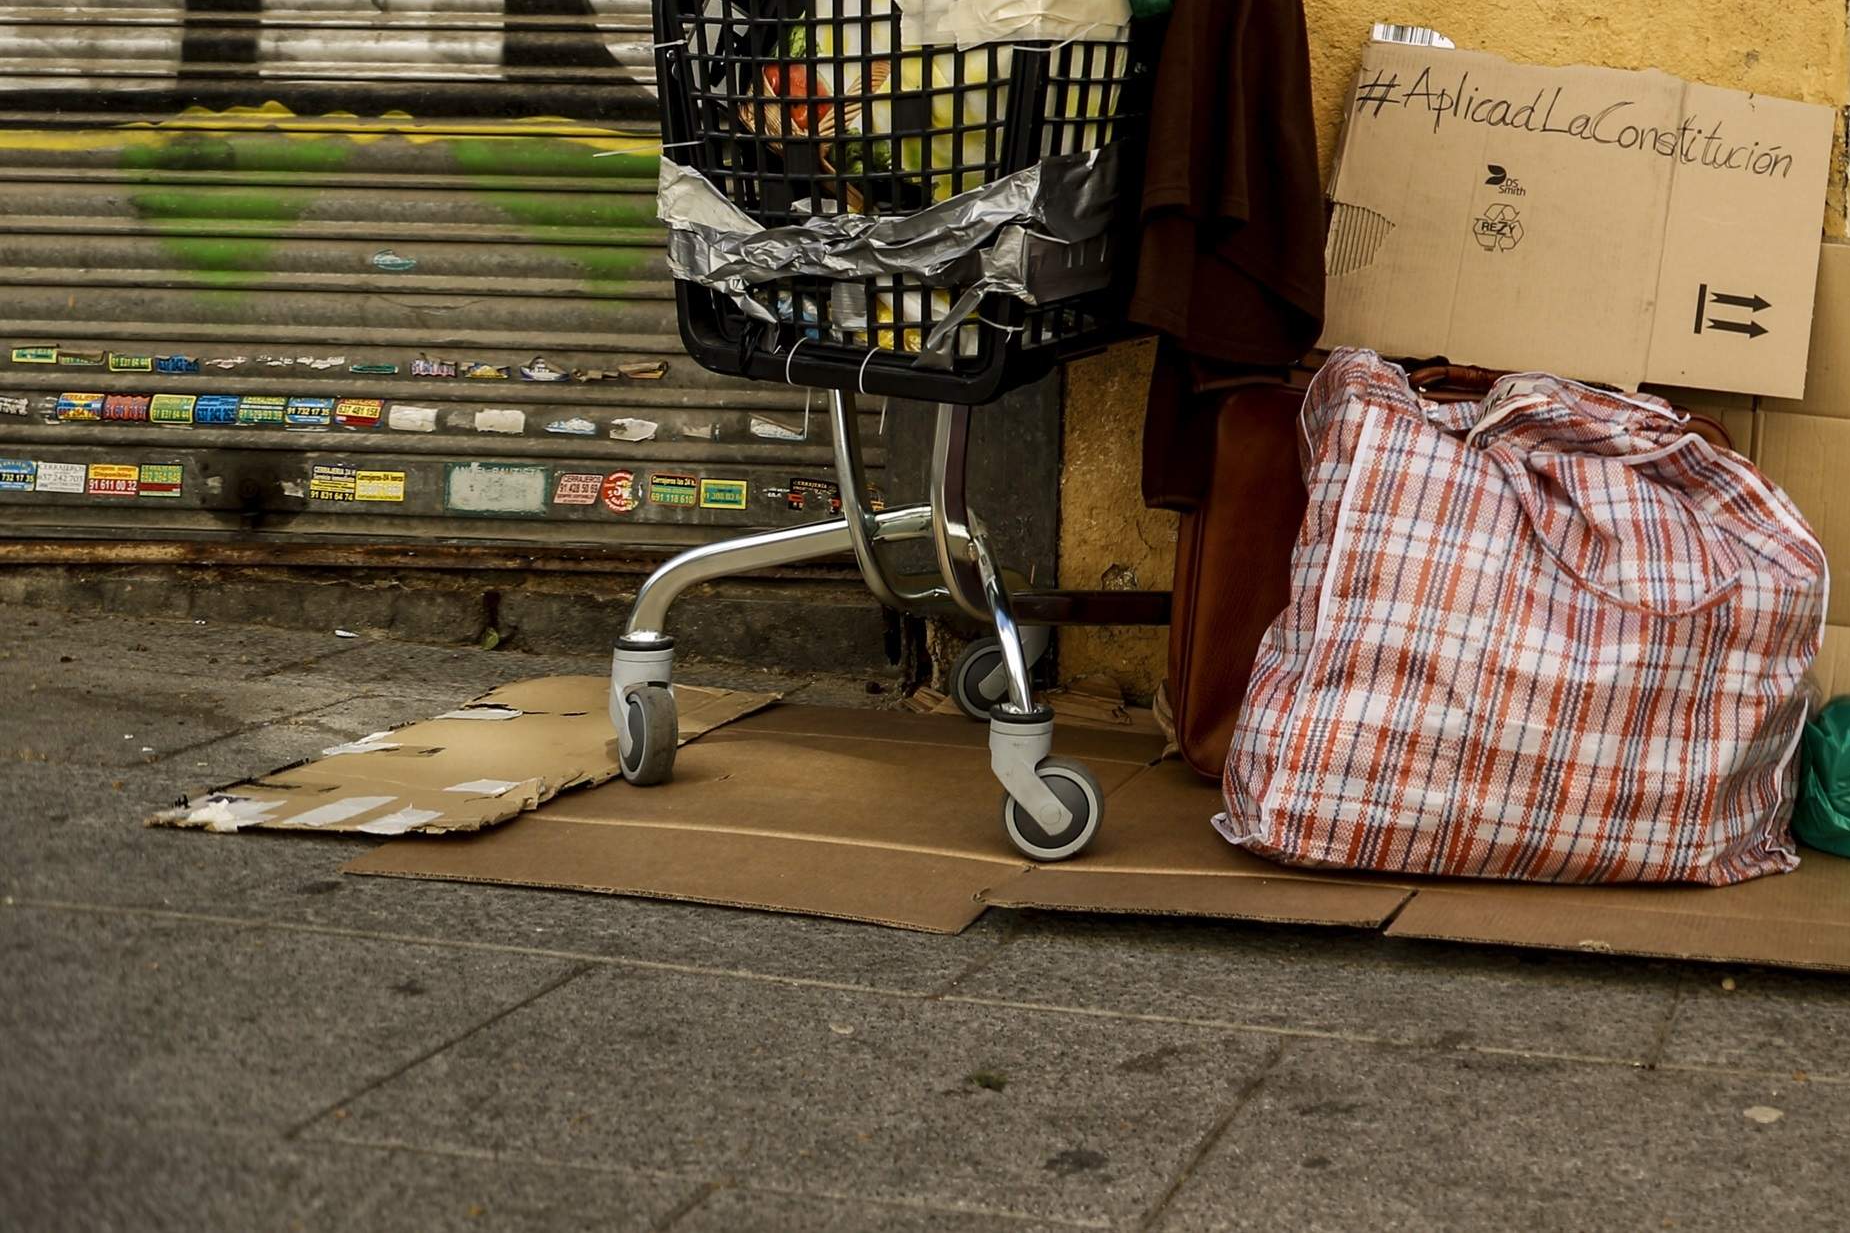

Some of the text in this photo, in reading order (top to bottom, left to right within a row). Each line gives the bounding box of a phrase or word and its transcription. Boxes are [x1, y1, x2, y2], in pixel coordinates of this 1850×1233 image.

[1356, 66, 1793, 178] #AplicadLaConstitución
[1506, 178, 1519, 188] DS
[1498, 185, 1526, 196] Smith
[1481, 221, 1516, 235] REZY
[287, 406, 294, 415] 91
[296, 406, 310, 416] 732
[311, 408, 320, 416] 17
[2, 473, 14, 482] 732
[89, 479, 98, 490] 91
[100, 479, 114, 490] 611
[127, 480, 137, 491] 32
[311, 490, 319, 499] 91
